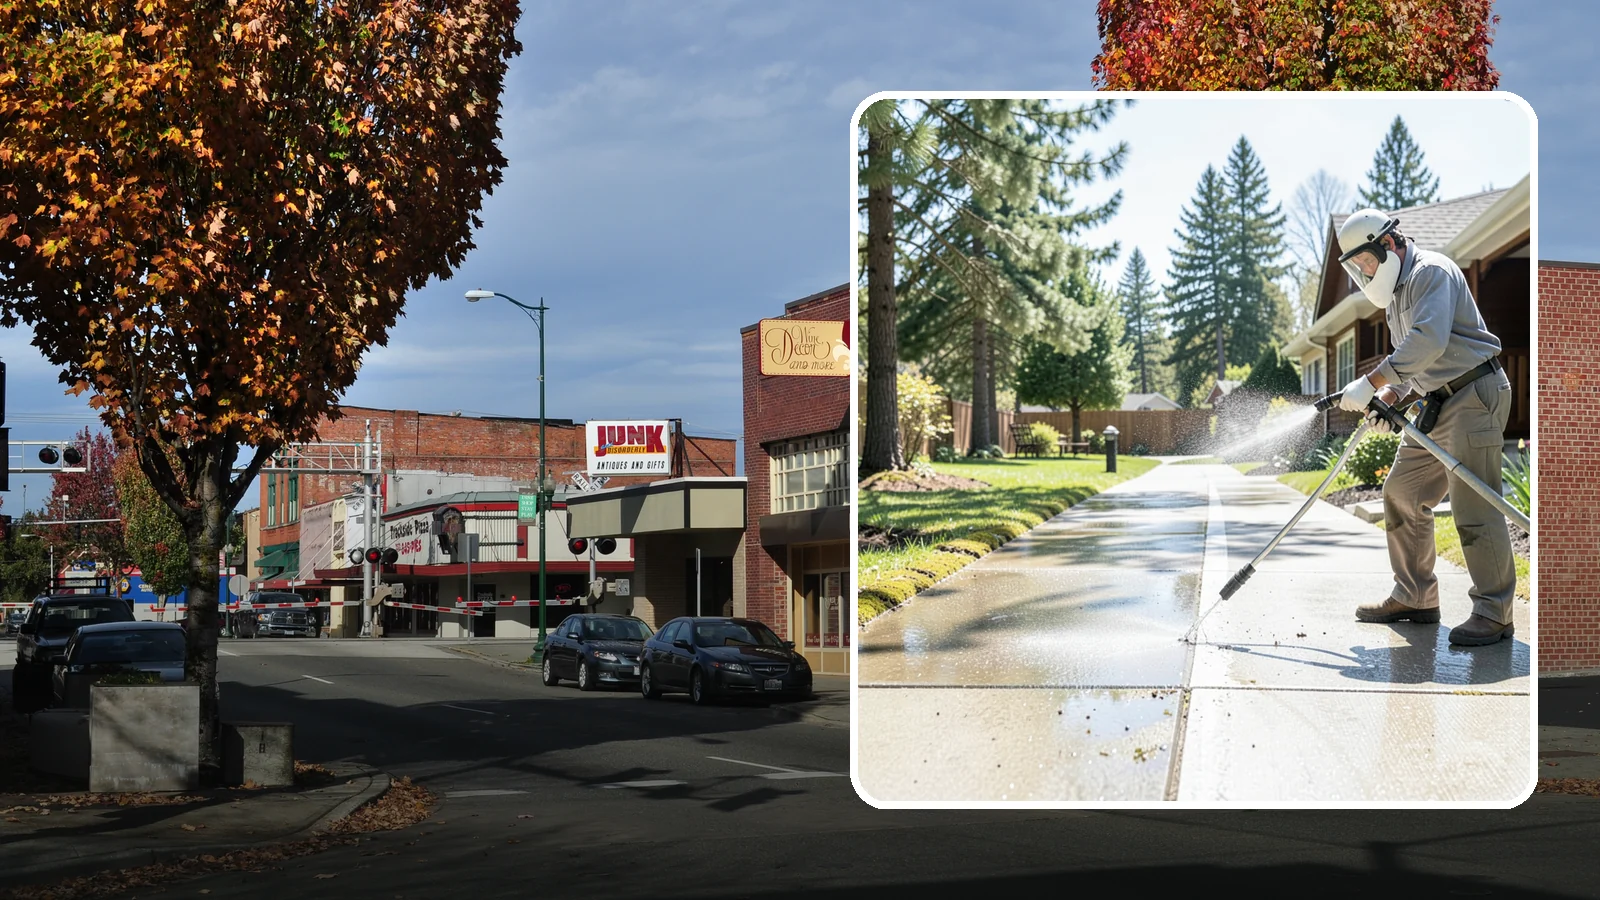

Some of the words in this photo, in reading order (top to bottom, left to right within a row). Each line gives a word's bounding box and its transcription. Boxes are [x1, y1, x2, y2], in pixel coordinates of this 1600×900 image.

[595, 425, 665, 457] JUNK
[607, 446, 645, 454] DISORDERLY
[597, 461, 628, 470] ANTIQUES
[631, 461, 644, 470] AND
[647, 460, 665, 469] GIFTS
[415, 520, 429, 535] Pizza
